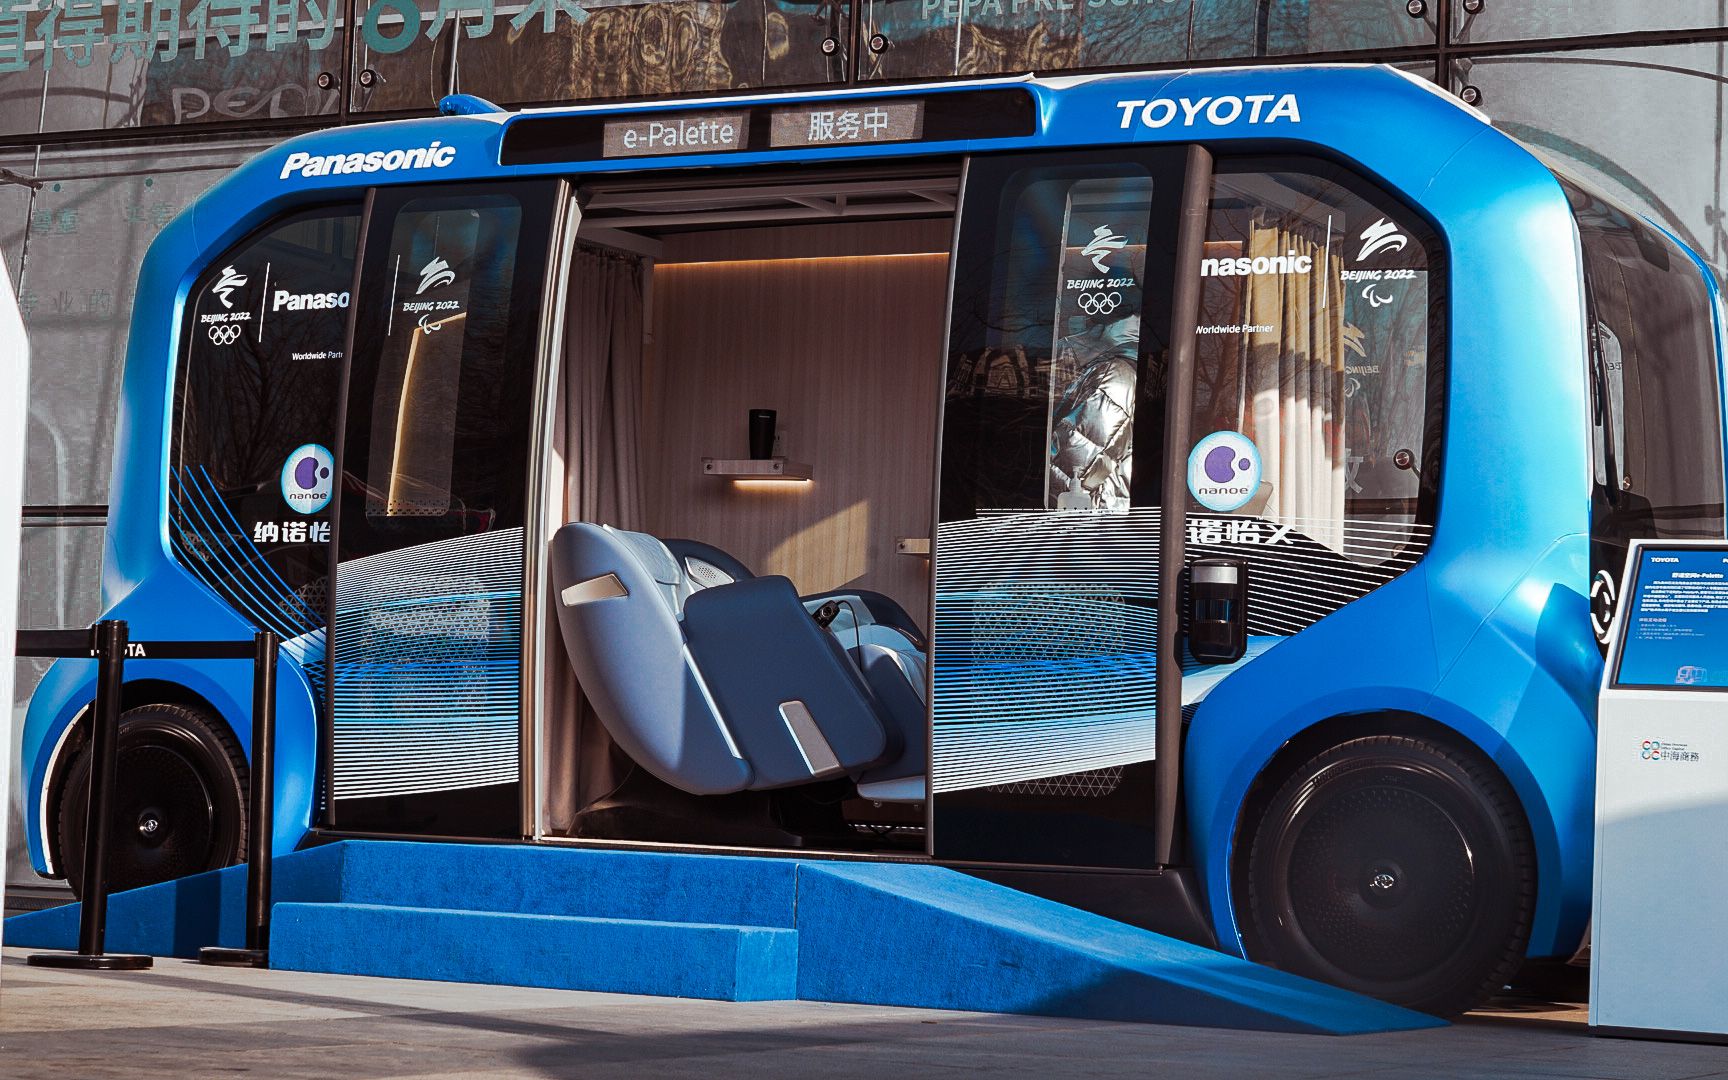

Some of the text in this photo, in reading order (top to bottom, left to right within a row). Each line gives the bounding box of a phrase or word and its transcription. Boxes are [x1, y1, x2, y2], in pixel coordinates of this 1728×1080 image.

[1116, 93, 1301, 129] TOYOTA
[807, 106, 889, 142] 服务中
[623, 119, 734, 149] e-Palette
[279, 140, 456, 180] Panasonic
[1200, 249, 1313, 277] nasonic
[1340, 268, 1418, 284] BEIJING 2022
[1066, 277, 1136, 292] BEIJING 2022
[272, 289, 350, 312] Panaso
[402, 300, 460, 314] BEIJING 2022
[200, 311, 252, 325] BEIJING 2022
[1241, 323, 1274, 333] Partner
[291, 351, 327, 361] Worldwide
[289, 492, 327, 500] nanoe
[1198, 487, 1249, 495] nanoe
[253, 521, 331, 543] 纳诺怡
